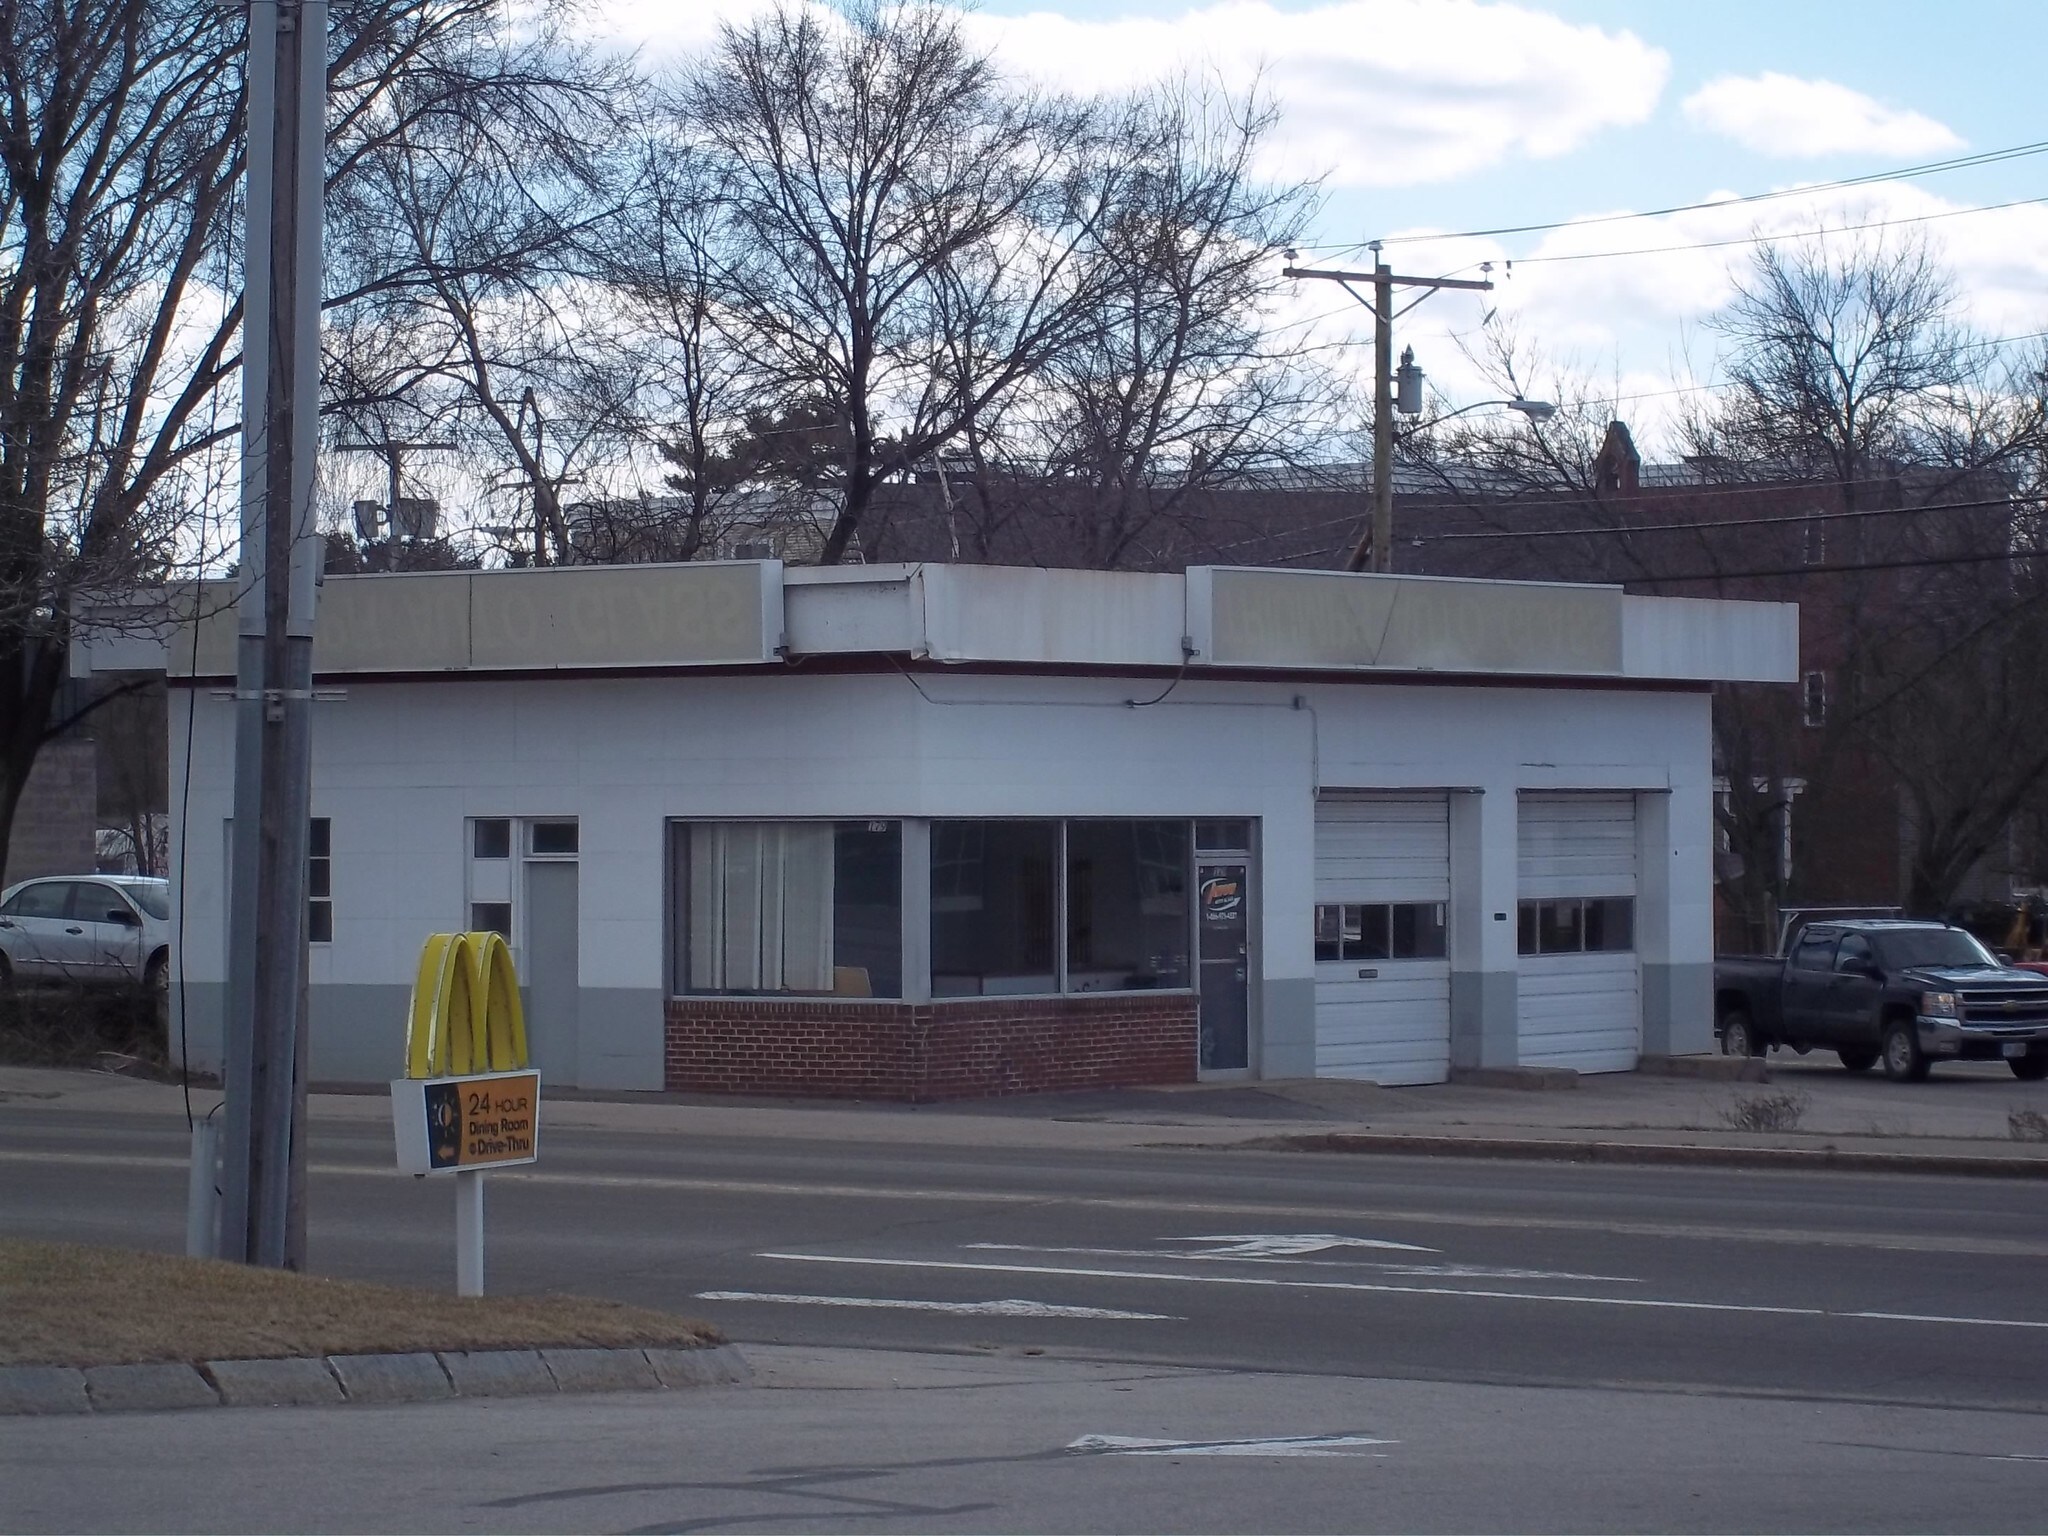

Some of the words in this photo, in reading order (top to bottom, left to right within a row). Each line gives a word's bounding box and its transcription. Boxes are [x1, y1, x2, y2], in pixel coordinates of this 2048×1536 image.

[469, 1092, 490, 1116] 24
[495, 1098, 529, 1113] HOUR
[469, 1121, 499, 1138] Dining
[501, 1118, 529, 1133] Room
[478, 1136, 530, 1156] Drive-Thru
